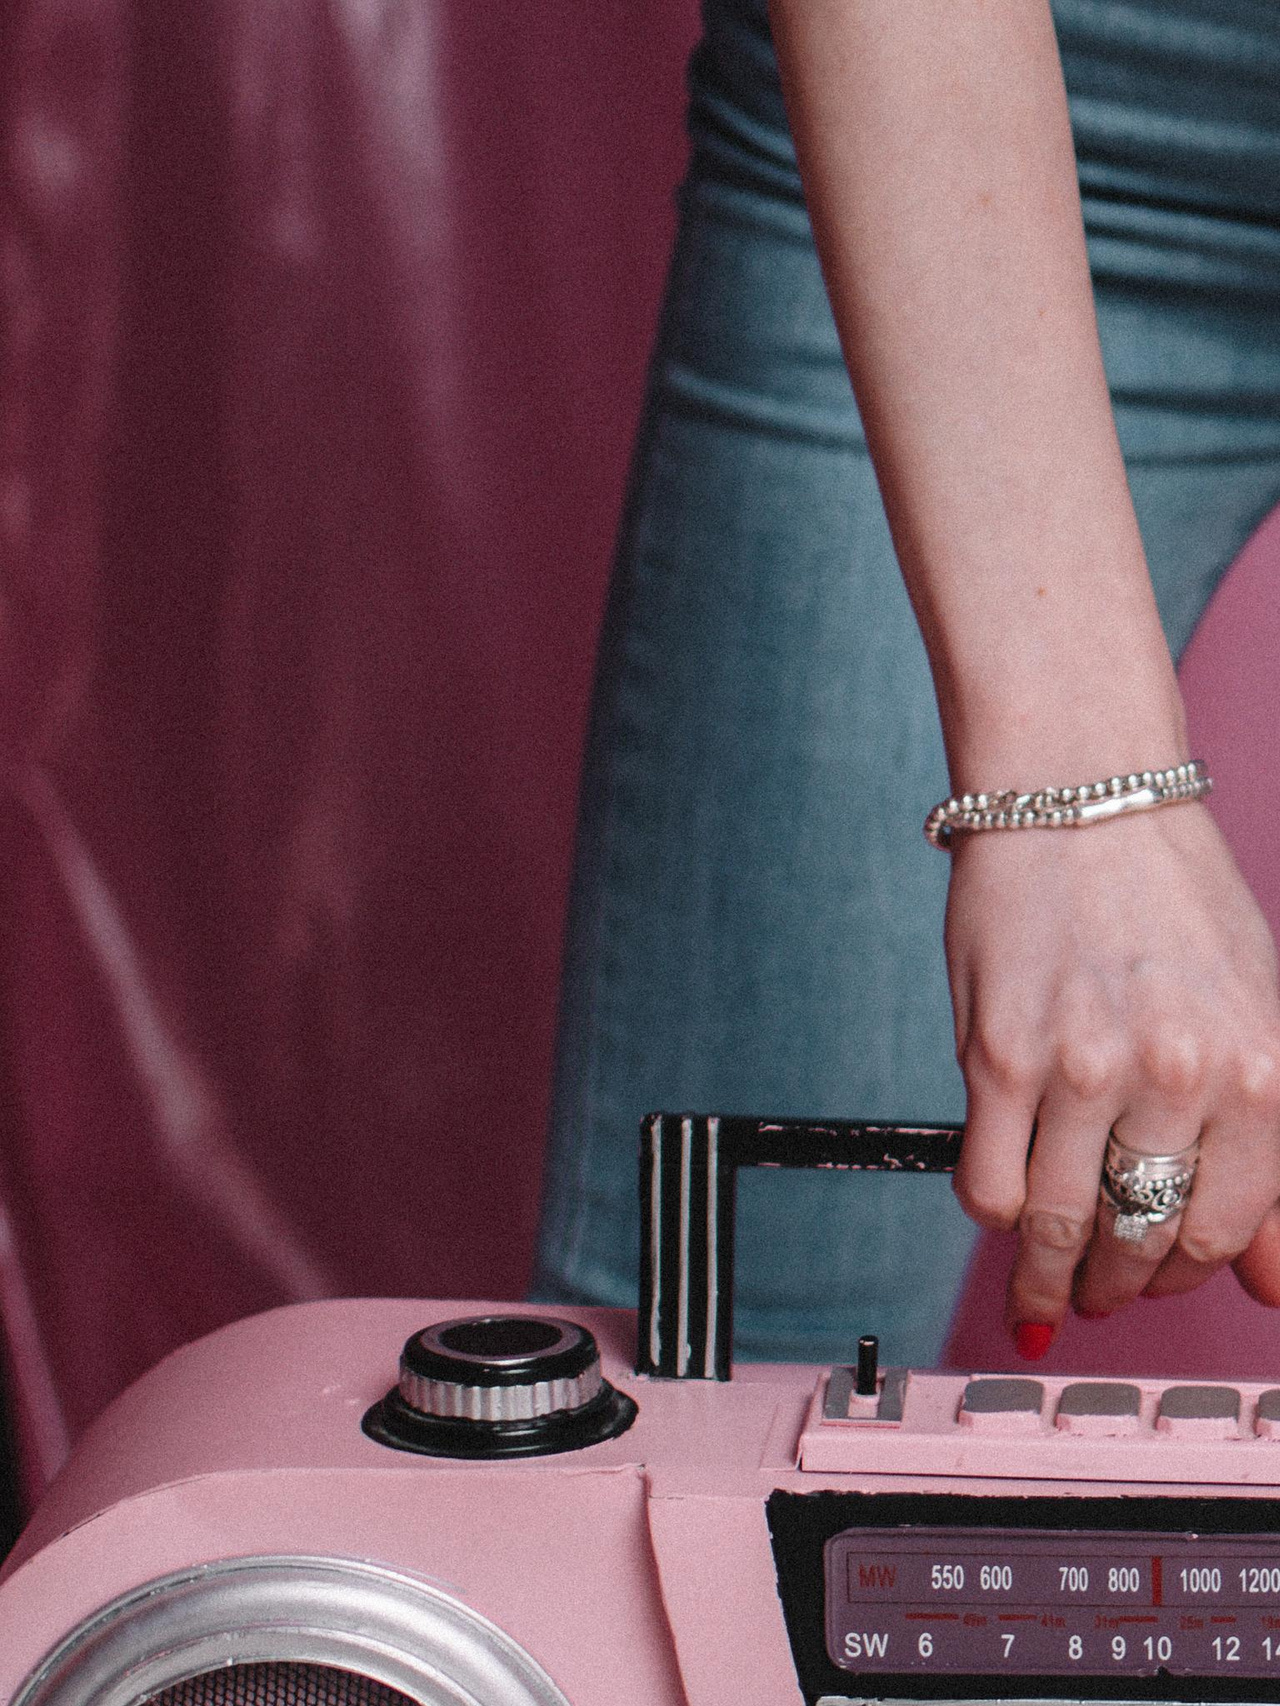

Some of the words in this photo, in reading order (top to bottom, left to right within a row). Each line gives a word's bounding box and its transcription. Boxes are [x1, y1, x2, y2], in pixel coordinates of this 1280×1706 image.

[857, 1565, 898, 1588] MW
[931, 1564, 965, 1590] 550
[979, 1565, 1013, 1591] 600
[1058, 1566, 1089, 1592] 700
[1108, 1567, 1140, 1593] 800
[1180, 1567, 1222, 1593] 1000
[844, 1632, 889, 1658] SW
[918, 1632, 934, 1658] 6
[1001, 1633, 1015, 1658] 7
[1068, 1634, 1083, 1660] 8
[1111, 1635, 1126, 1661] 9
[1143, 1635, 1172, 1661] 10
[1212, 1636, 1241, 1661] 12
